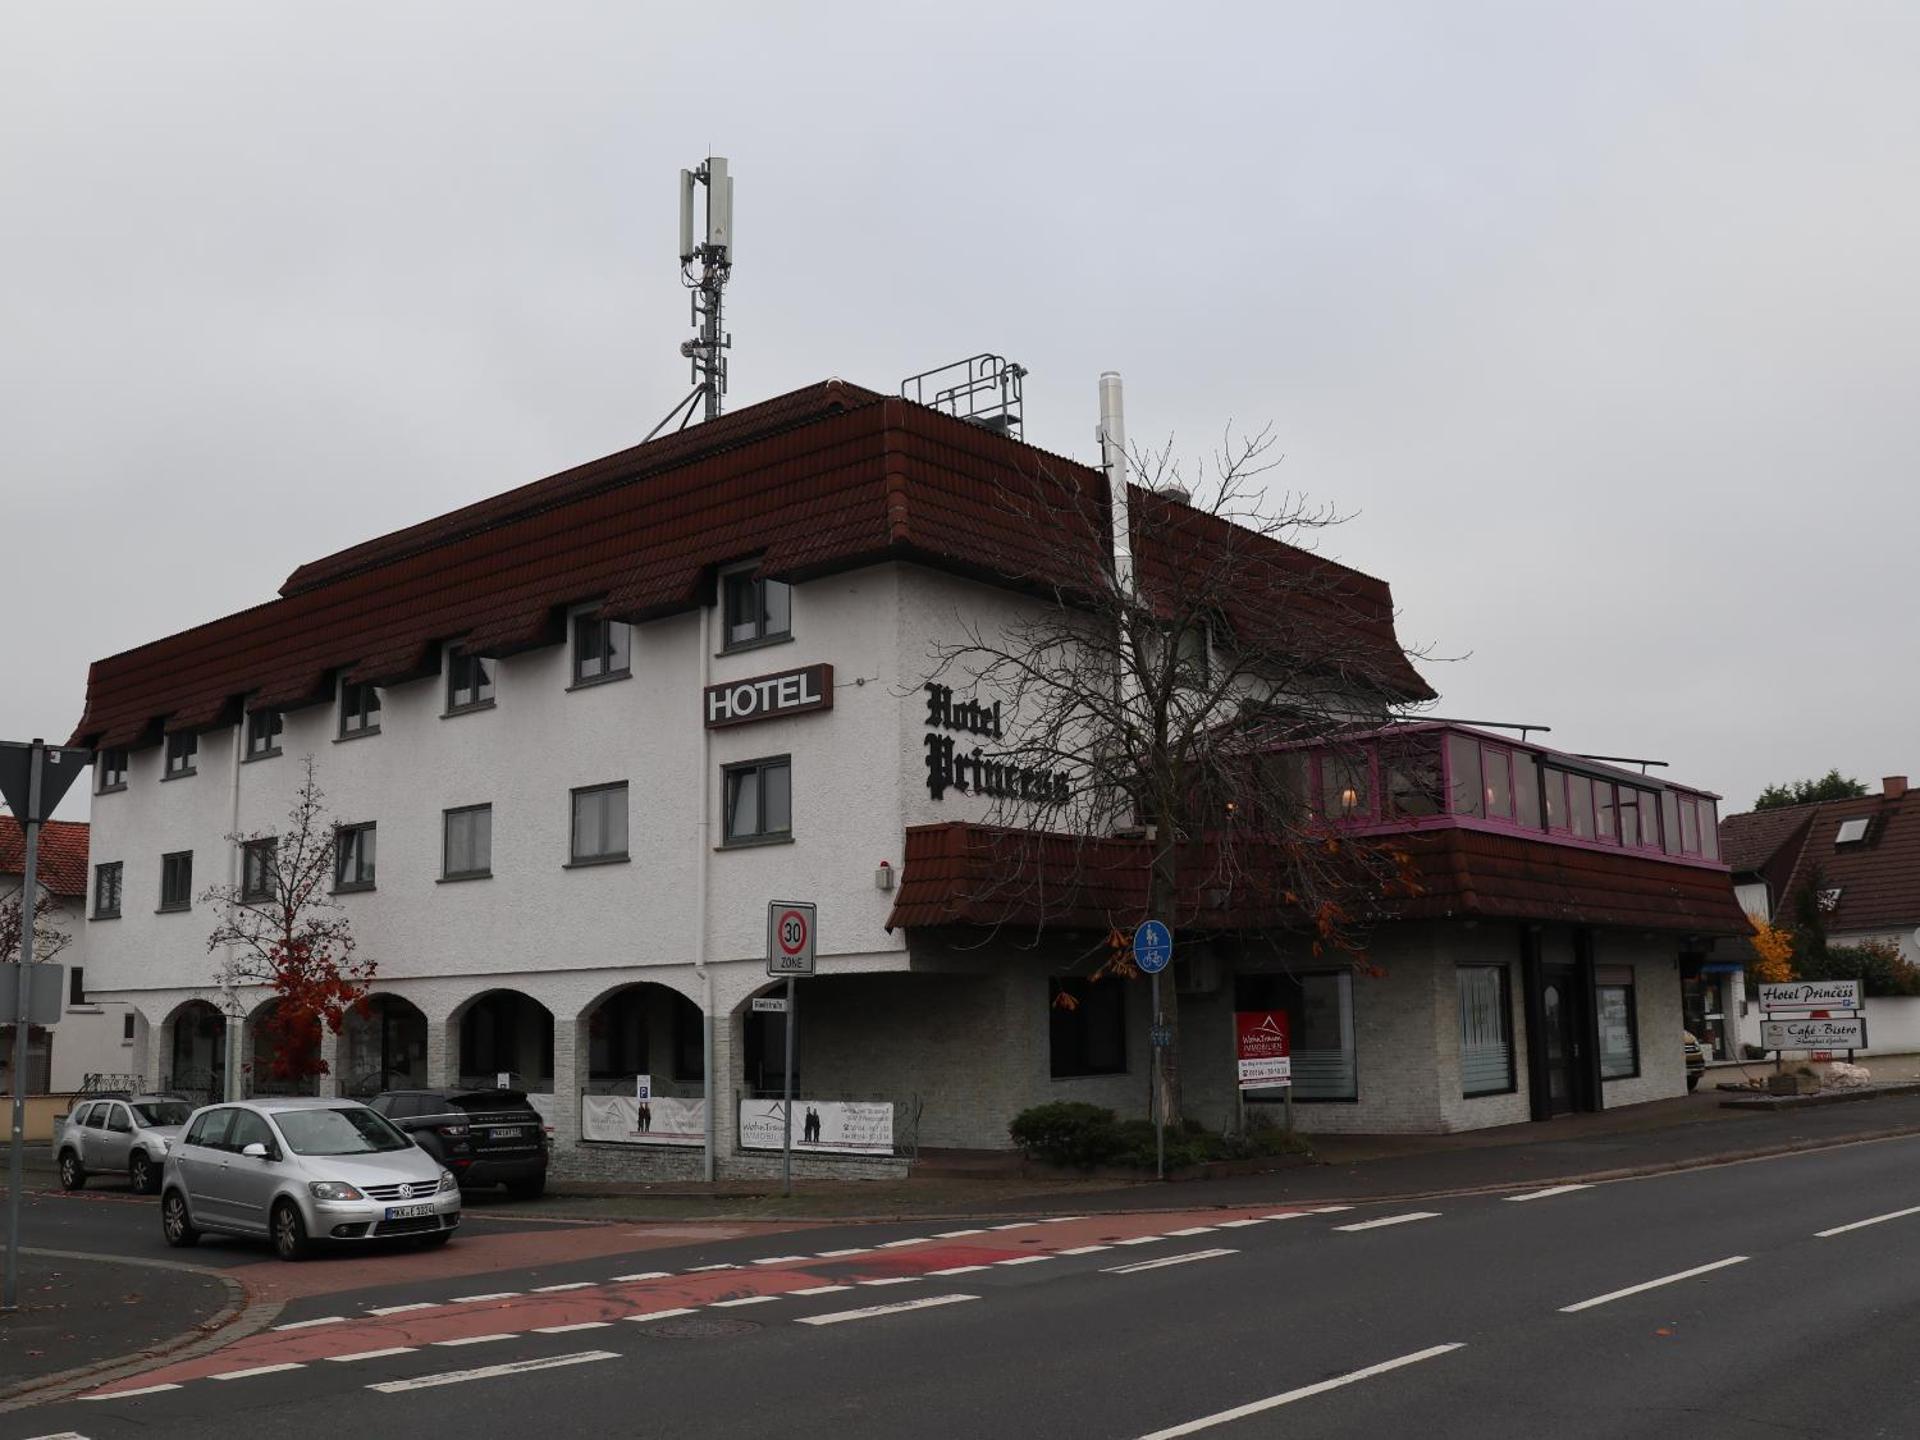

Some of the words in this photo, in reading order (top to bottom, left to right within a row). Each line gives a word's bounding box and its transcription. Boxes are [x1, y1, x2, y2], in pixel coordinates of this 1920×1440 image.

[709, 673, 821, 721] HOTEL
[924, 682, 1002, 739] Hotel
[924, 733, 1070, 804] Princess
[784, 922, 801, 943] 30
[781, 957, 803, 968] ZONE
[1764, 987, 1799, 1001] Hotel
[1801, 985, 1853, 1002] Princess
[1788, 1024, 1816, 1039] Café
[1824, 1023, 1857, 1035] Bistro
